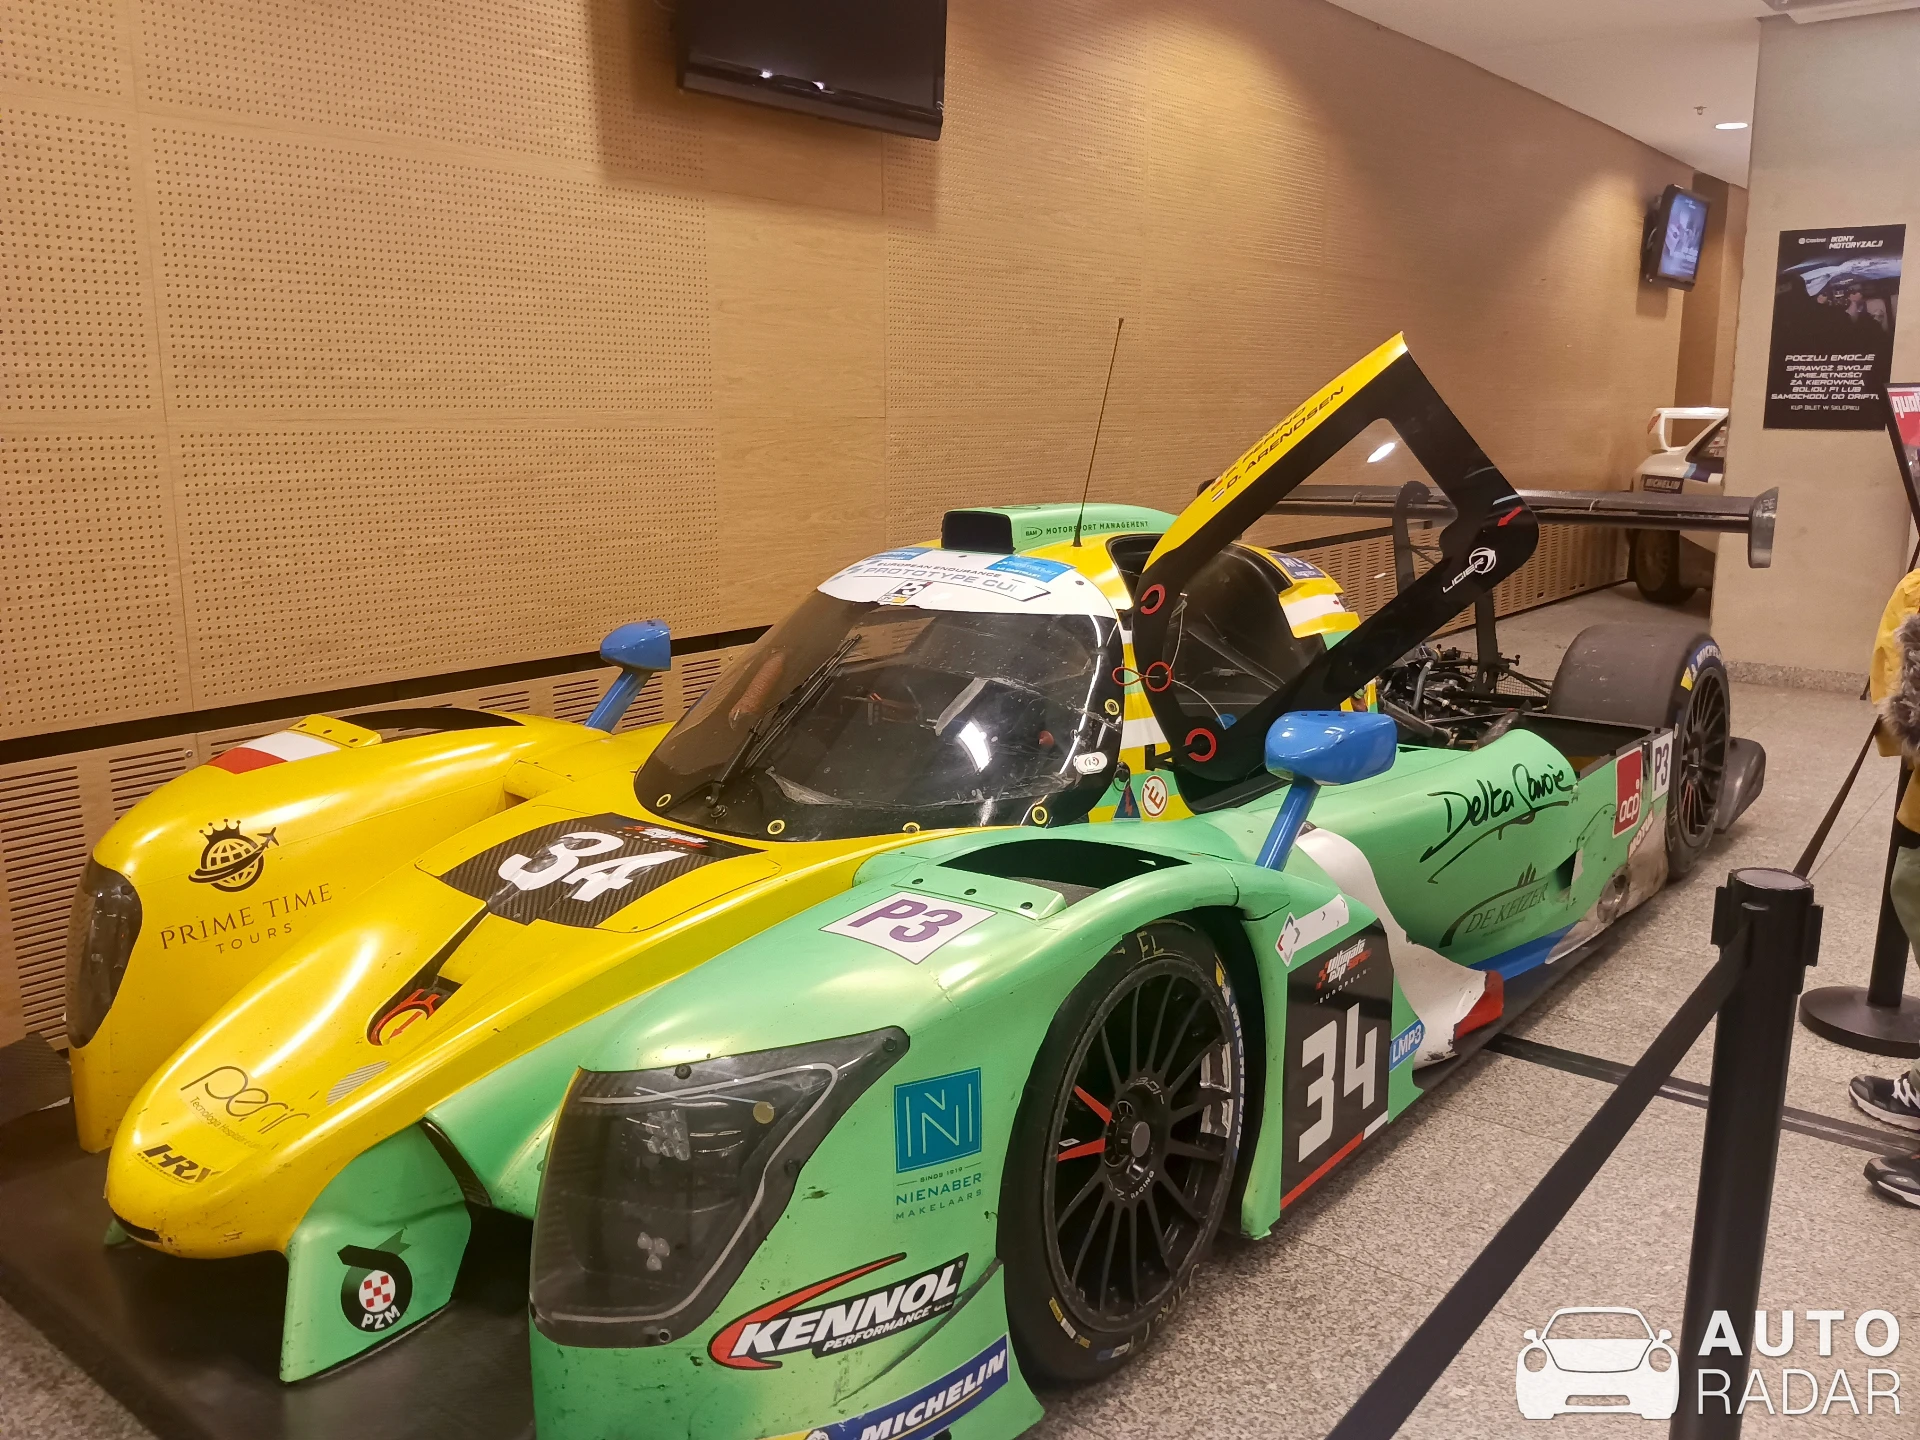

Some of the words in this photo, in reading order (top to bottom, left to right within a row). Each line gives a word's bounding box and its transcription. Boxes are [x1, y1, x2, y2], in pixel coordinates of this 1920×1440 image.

[1828, 240, 1884, 250] MOTORYZACJI
[1830, 235, 1855, 243] IKONY
[1784, 354, 1828, 362] POCZUJ
[1830, 353, 1876, 362] EMOCJE
[1794, 371, 1862, 379] UMIEJĘTNOŚCI
[1244, 385, 1344, 473] ARENDSEN
[1646, 478, 1681, 490] MICHELIN
[1099, 520, 1149, 530] MANAGEMENT
[863, 566, 975, 584] PROTOTYPE
[877, 562, 933, 570] EUROPEAN
[933, 565, 1002, 578] ENDURANCE
[1442, 557, 1485, 593] LIGIER
[1653, 743, 1670, 792] P3
[498, 831, 689, 903] 34
[160, 906, 255, 950] PRIME
[262, 882, 333, 918] TIME
[847, 898, 963, 943] P3
[1465, 907, 1496, 934] DE
[1495, 882, 1549, 924] KEIZER
[216, 922, 293, 954] TOURS
[1392, 1024, 1422, 1064] LMP3
[1230, 1002, 1245, 1150] MICHELIN
[1298, 1002, 1377, 1162] 34
[190, 1096, 222, 1128] Tecnologia
[896, 1172, 982, 1206] NIENABER
[920, 1172, 943, 1183] SINDS
[1130, 1170, 1155, 1199] RACING
[895, 1188, 982, 1220] MAKELAARS
[361, 1304, 400, 1330] PZM
[730, 1264, 958, 1357] KENNOL
[822, 1306, 930, 1352] PERFORMANCE
[859, 1349, 1006, 1440] MICHELIN
